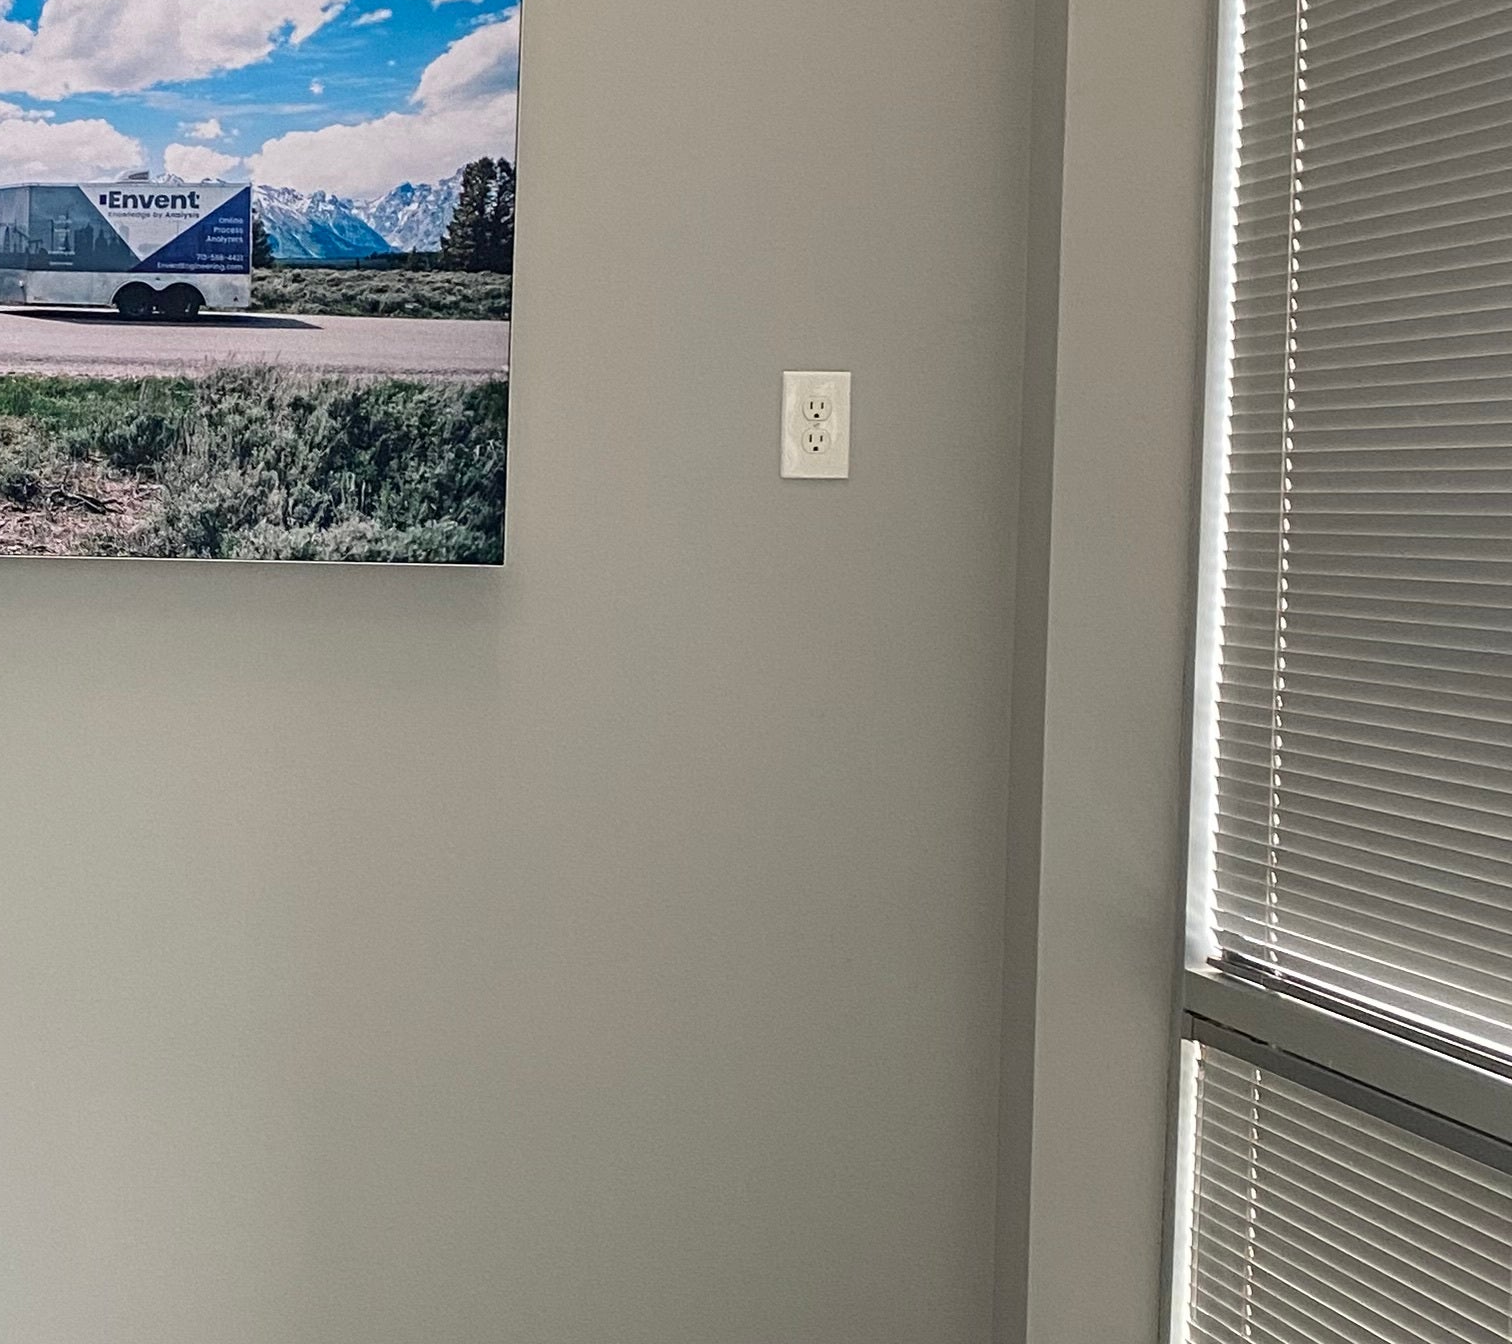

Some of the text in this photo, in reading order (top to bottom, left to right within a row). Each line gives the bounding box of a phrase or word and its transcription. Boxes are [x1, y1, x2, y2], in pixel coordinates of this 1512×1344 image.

[108, 190, 200, 209] Envent
[165, 211, 200, 219] Analysis
[213, 226, 244, 234] Process
